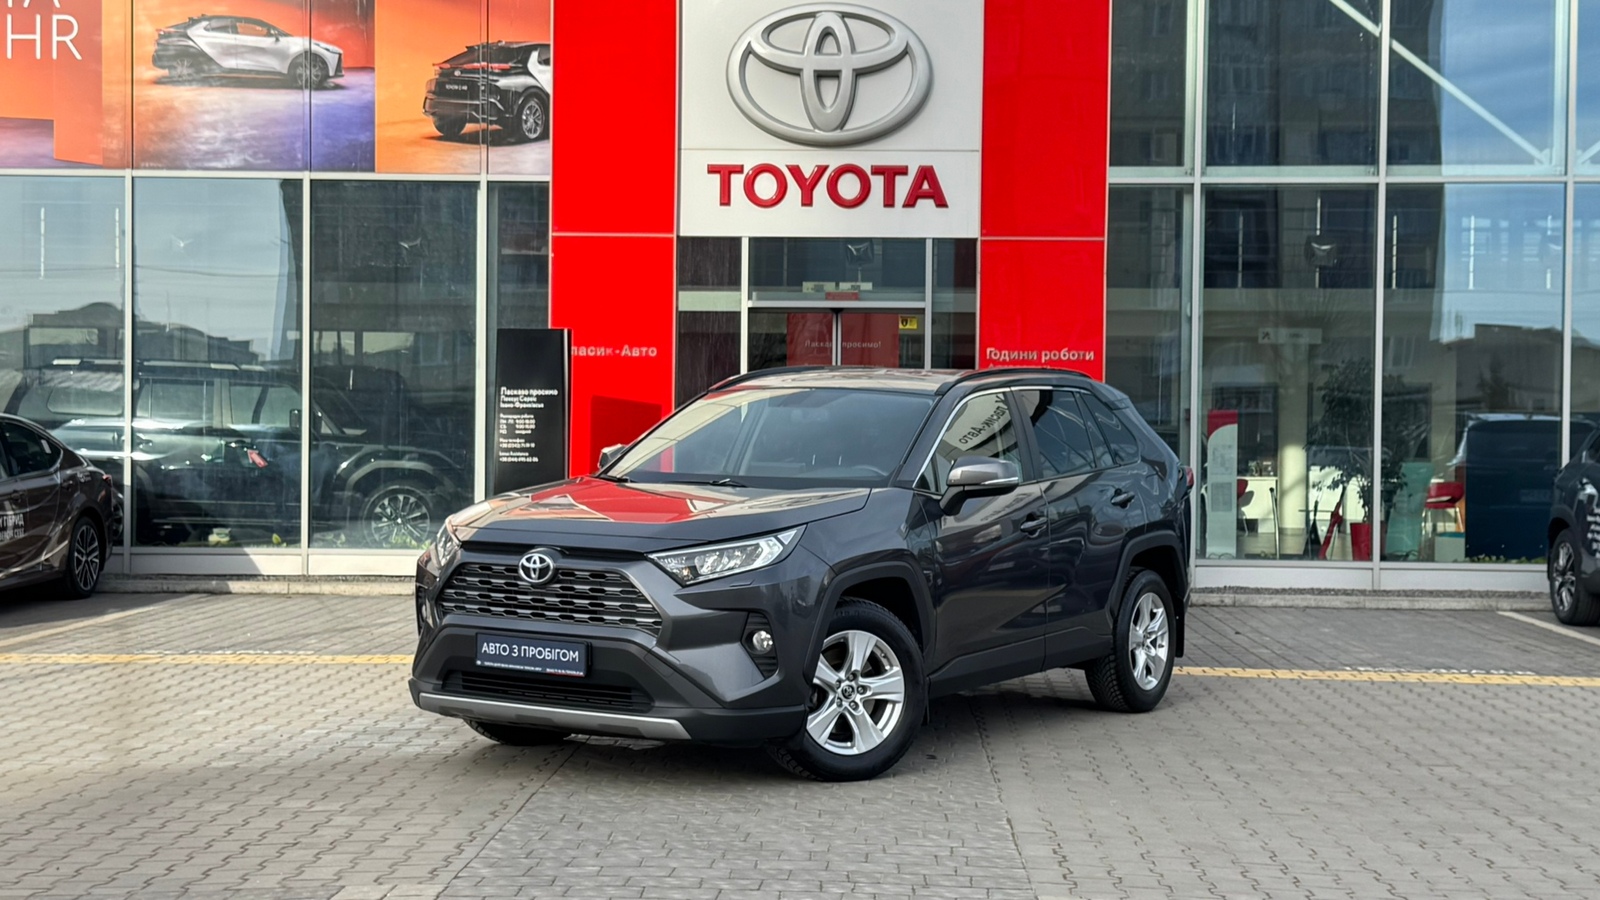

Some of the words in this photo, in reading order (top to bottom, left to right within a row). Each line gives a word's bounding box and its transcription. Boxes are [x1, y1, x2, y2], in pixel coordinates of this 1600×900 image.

[707, 163, 949, 209] TOYOTA
[571, 344, 658, 358] ласик-Авто
[986, 347, 1038, 362] Години
[1041, 347, 1095, 364] роботи
[481, 642, 510, 656] АВТО
[511, 644, 519, 657] З
[520, 645, 579, 663] ПРОБІГОМ
